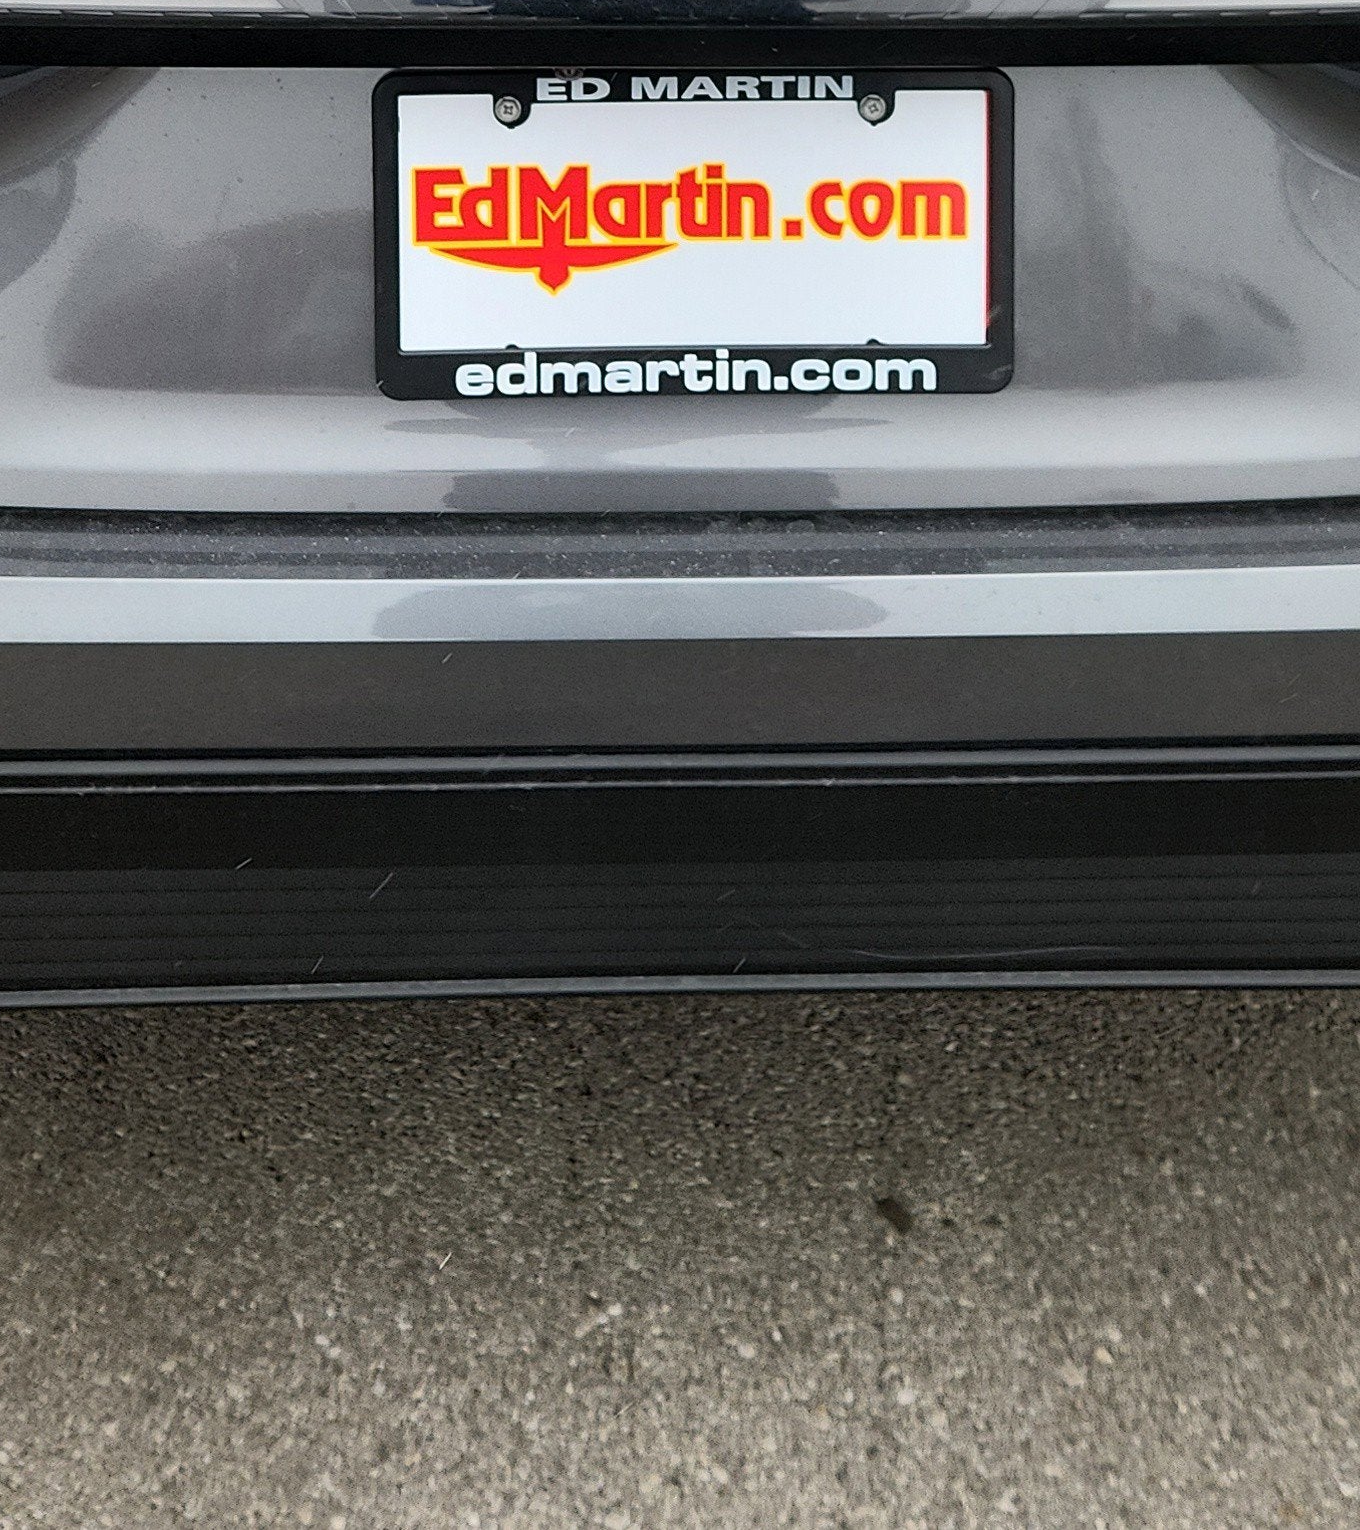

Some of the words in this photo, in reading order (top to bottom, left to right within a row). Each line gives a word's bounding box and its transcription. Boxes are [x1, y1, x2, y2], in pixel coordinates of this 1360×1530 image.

[536, 77, 611, 100] ED
[631, 75, 854, 99] MARTIN
[412, 163, 968, 245] EdMartin.com
[455, 349, 937, 397] edmartin.com
